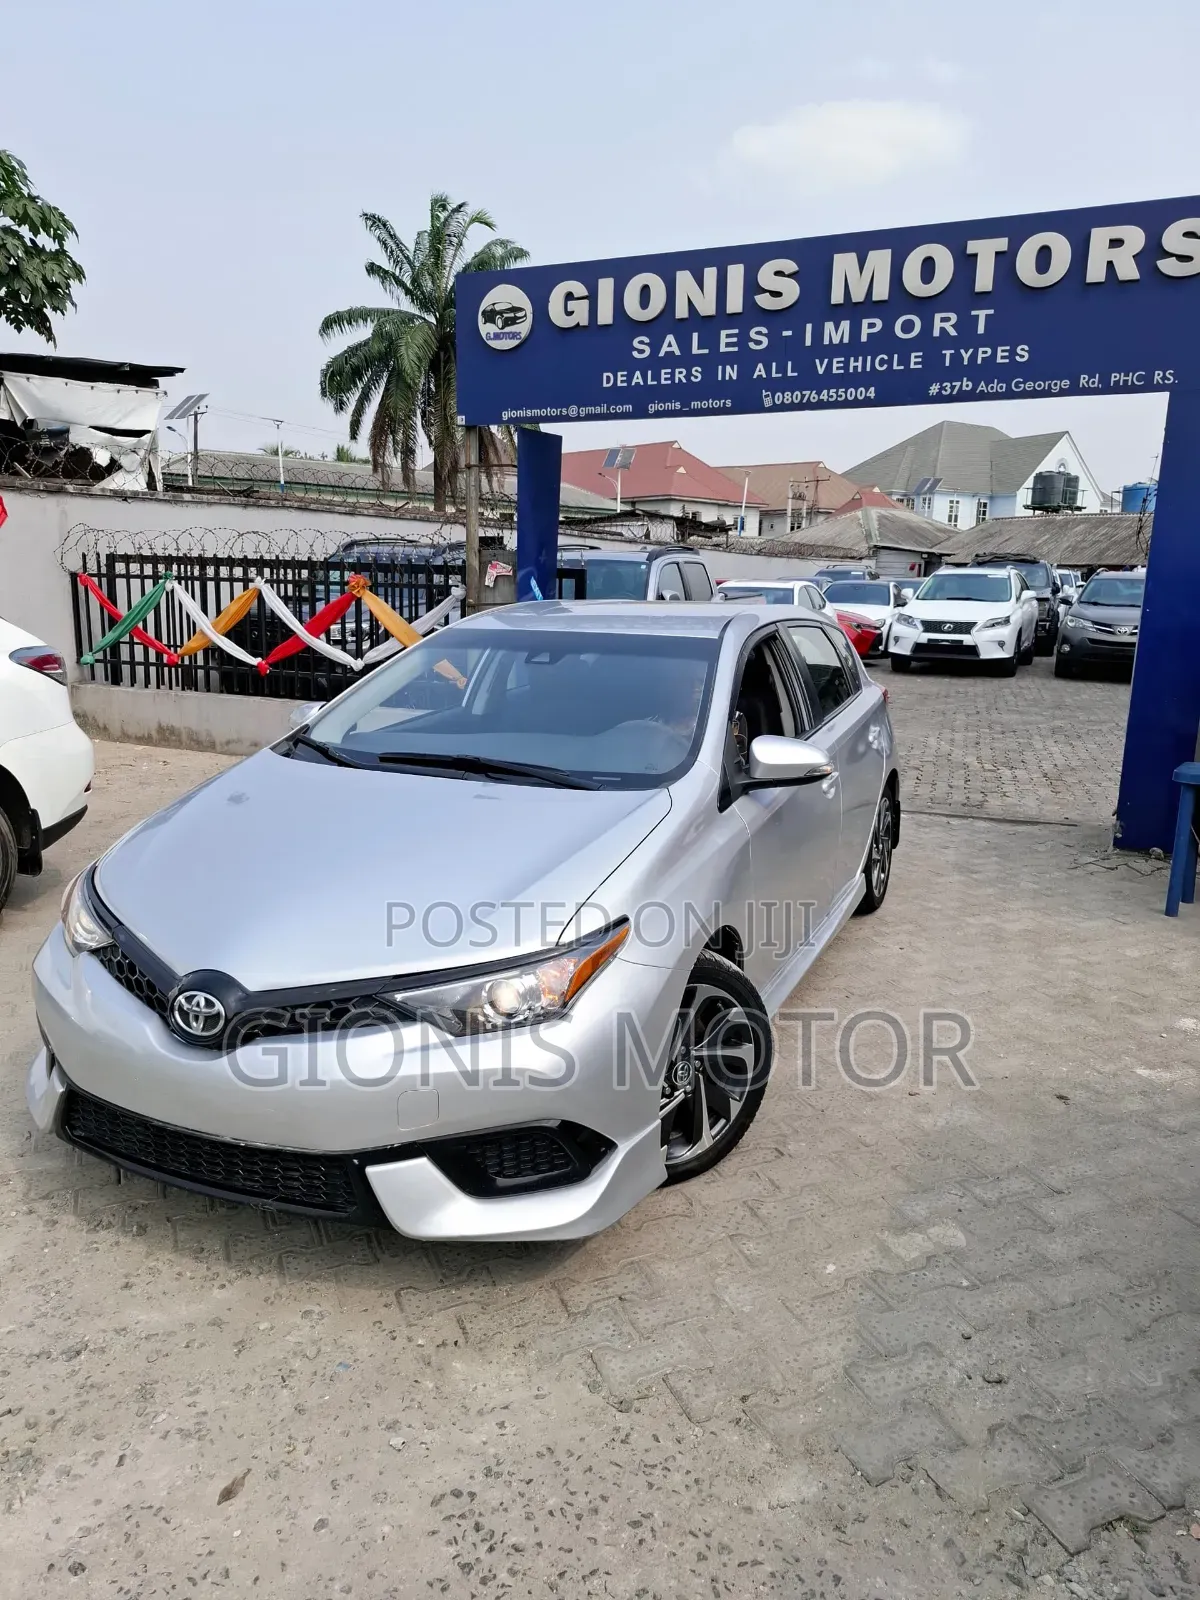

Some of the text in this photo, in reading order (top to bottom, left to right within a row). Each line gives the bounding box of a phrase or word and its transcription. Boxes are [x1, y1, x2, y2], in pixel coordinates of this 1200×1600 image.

[548, 217, 1200, 329] GIONIS MOTORS
[602, 345, 1030, 388] DEALERS IN ALL VEHICLE TYPES
[774, 387, 876, 405] 08076455004
[928, 379, 973, 397] #37b
[976, 380, 1006, 394] Ada
[1011, 378, 1071, 395] George
[1110, 372, 1145, 387] PHC
[1153, 370, 1179, 384] RS.
[501, 403, 633, 421] gionismotors@gmail.com
